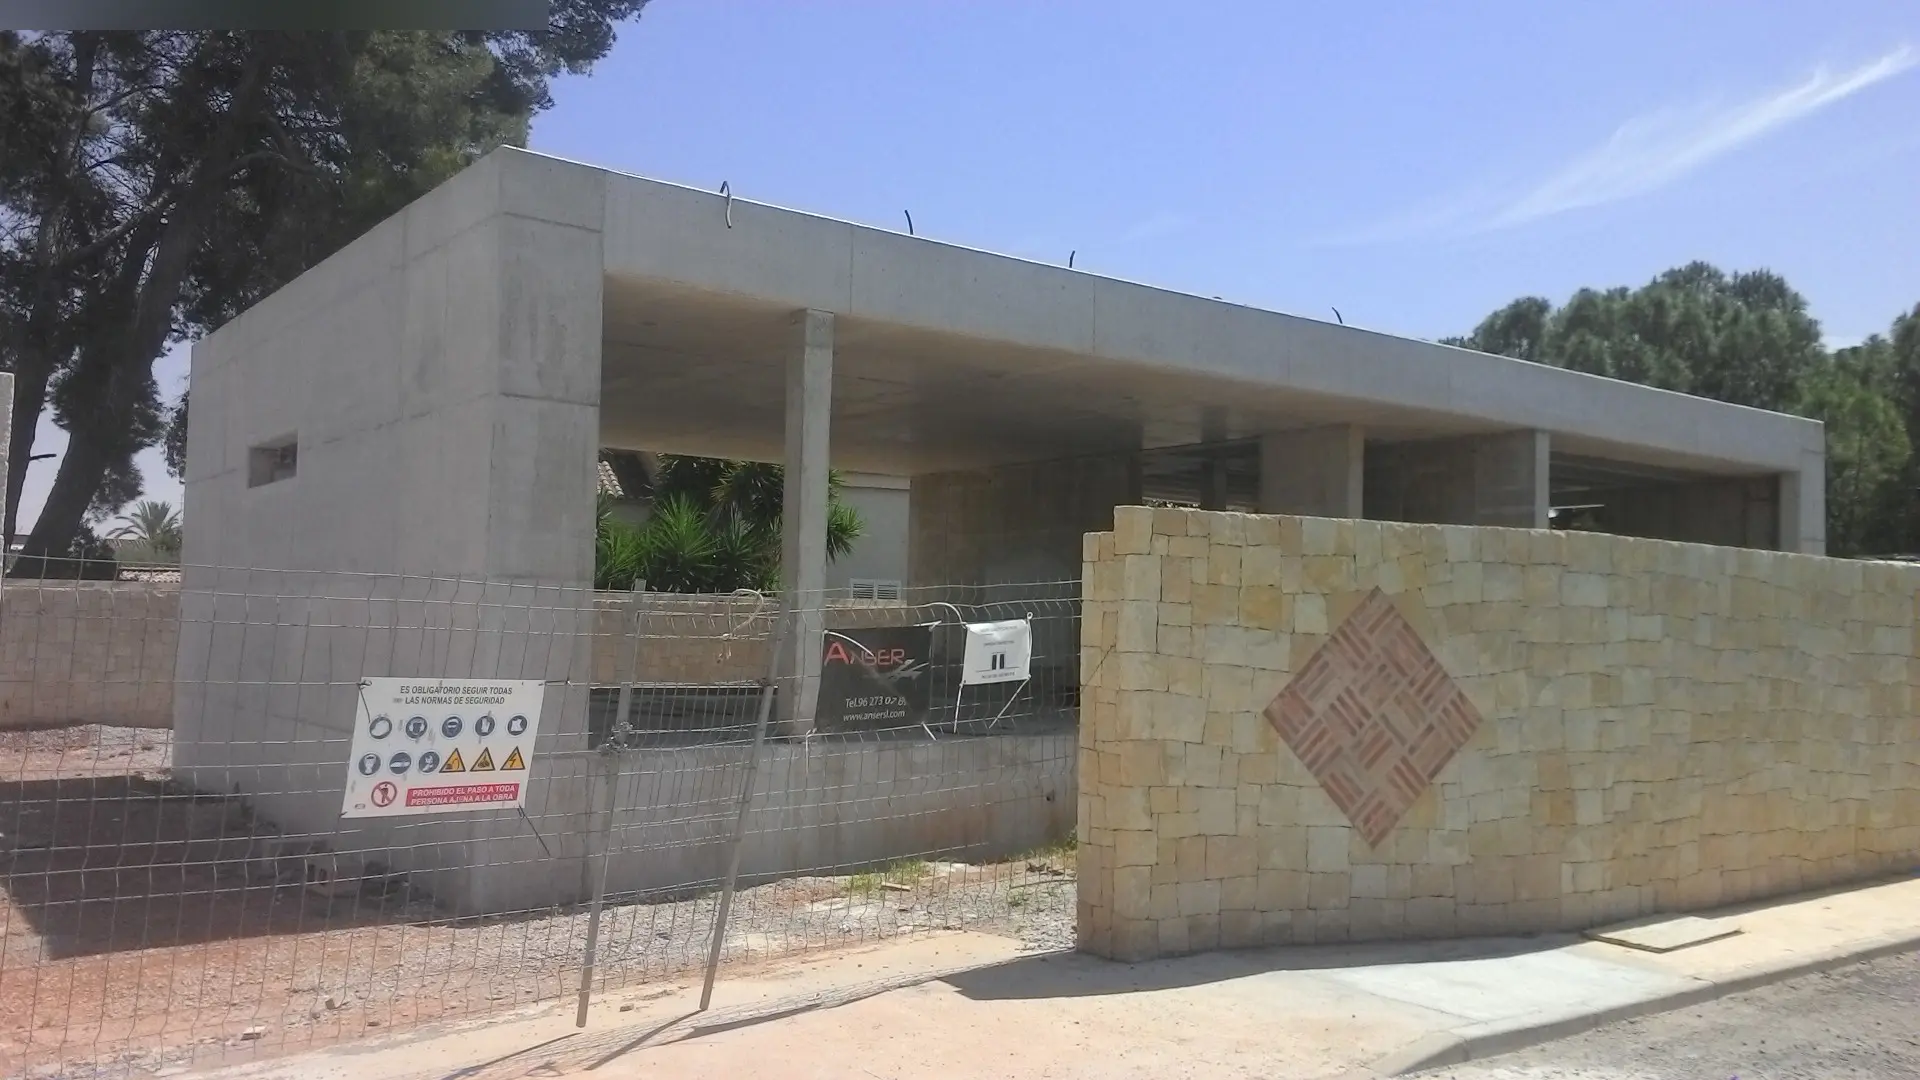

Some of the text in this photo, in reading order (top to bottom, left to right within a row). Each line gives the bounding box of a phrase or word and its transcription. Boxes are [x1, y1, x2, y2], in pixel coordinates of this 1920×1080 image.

[400, 686, 410, 694] ES
[412, 686, 460, 694] OBLIGATORIO
[490, 687, 512, 695] TODAS
[869, 696, 883, 706] 273
[843, 710, 905, 721] www.ansersl.com
[412, 788, 455, 797] PROHIBIDO
[467, 786, 487, 794] PASO
[495, 785, 515, 793] TODA
[410, 797, 448, 806] PERSONA
[492, 793, 513, 801] OBRA
